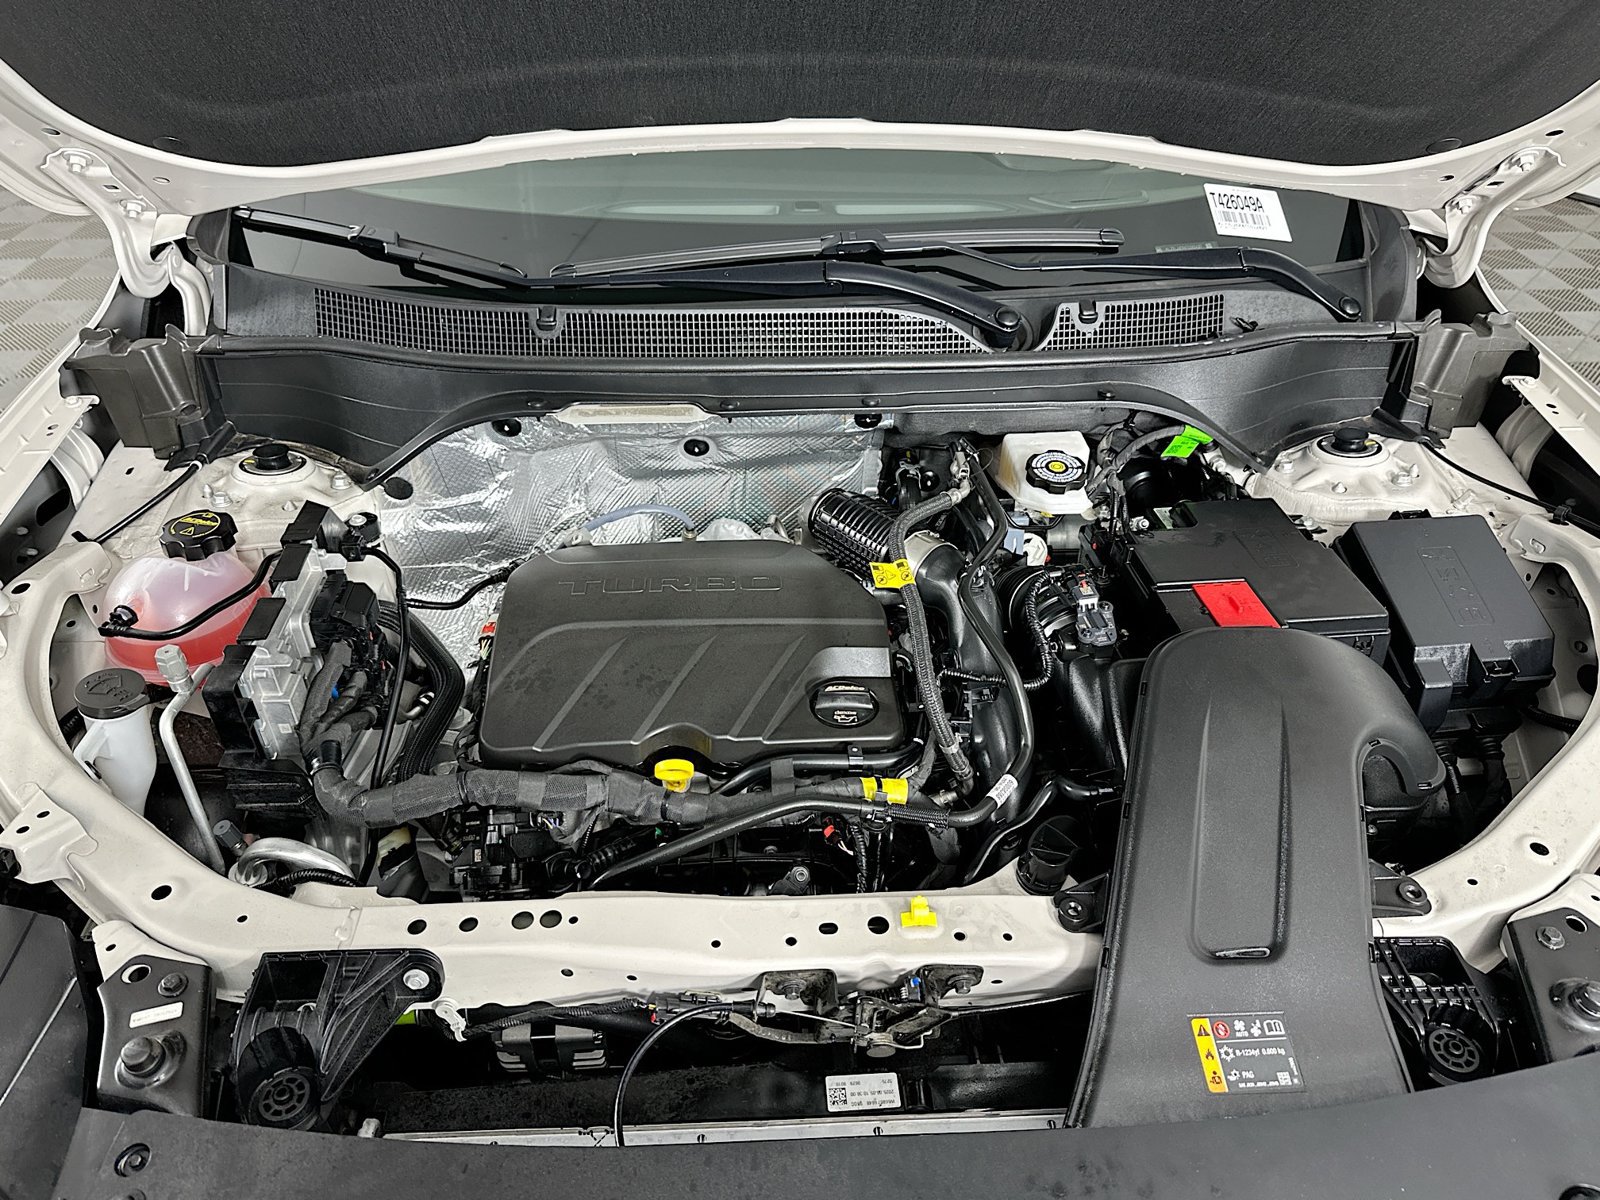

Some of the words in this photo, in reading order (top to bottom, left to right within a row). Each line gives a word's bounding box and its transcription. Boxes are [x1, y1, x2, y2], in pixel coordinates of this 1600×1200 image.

[1209, 191, 1265, 213] T426049A
[557, 576, 783, 595] TURBO
[1241, 1071, 1255, 1079] PAG
